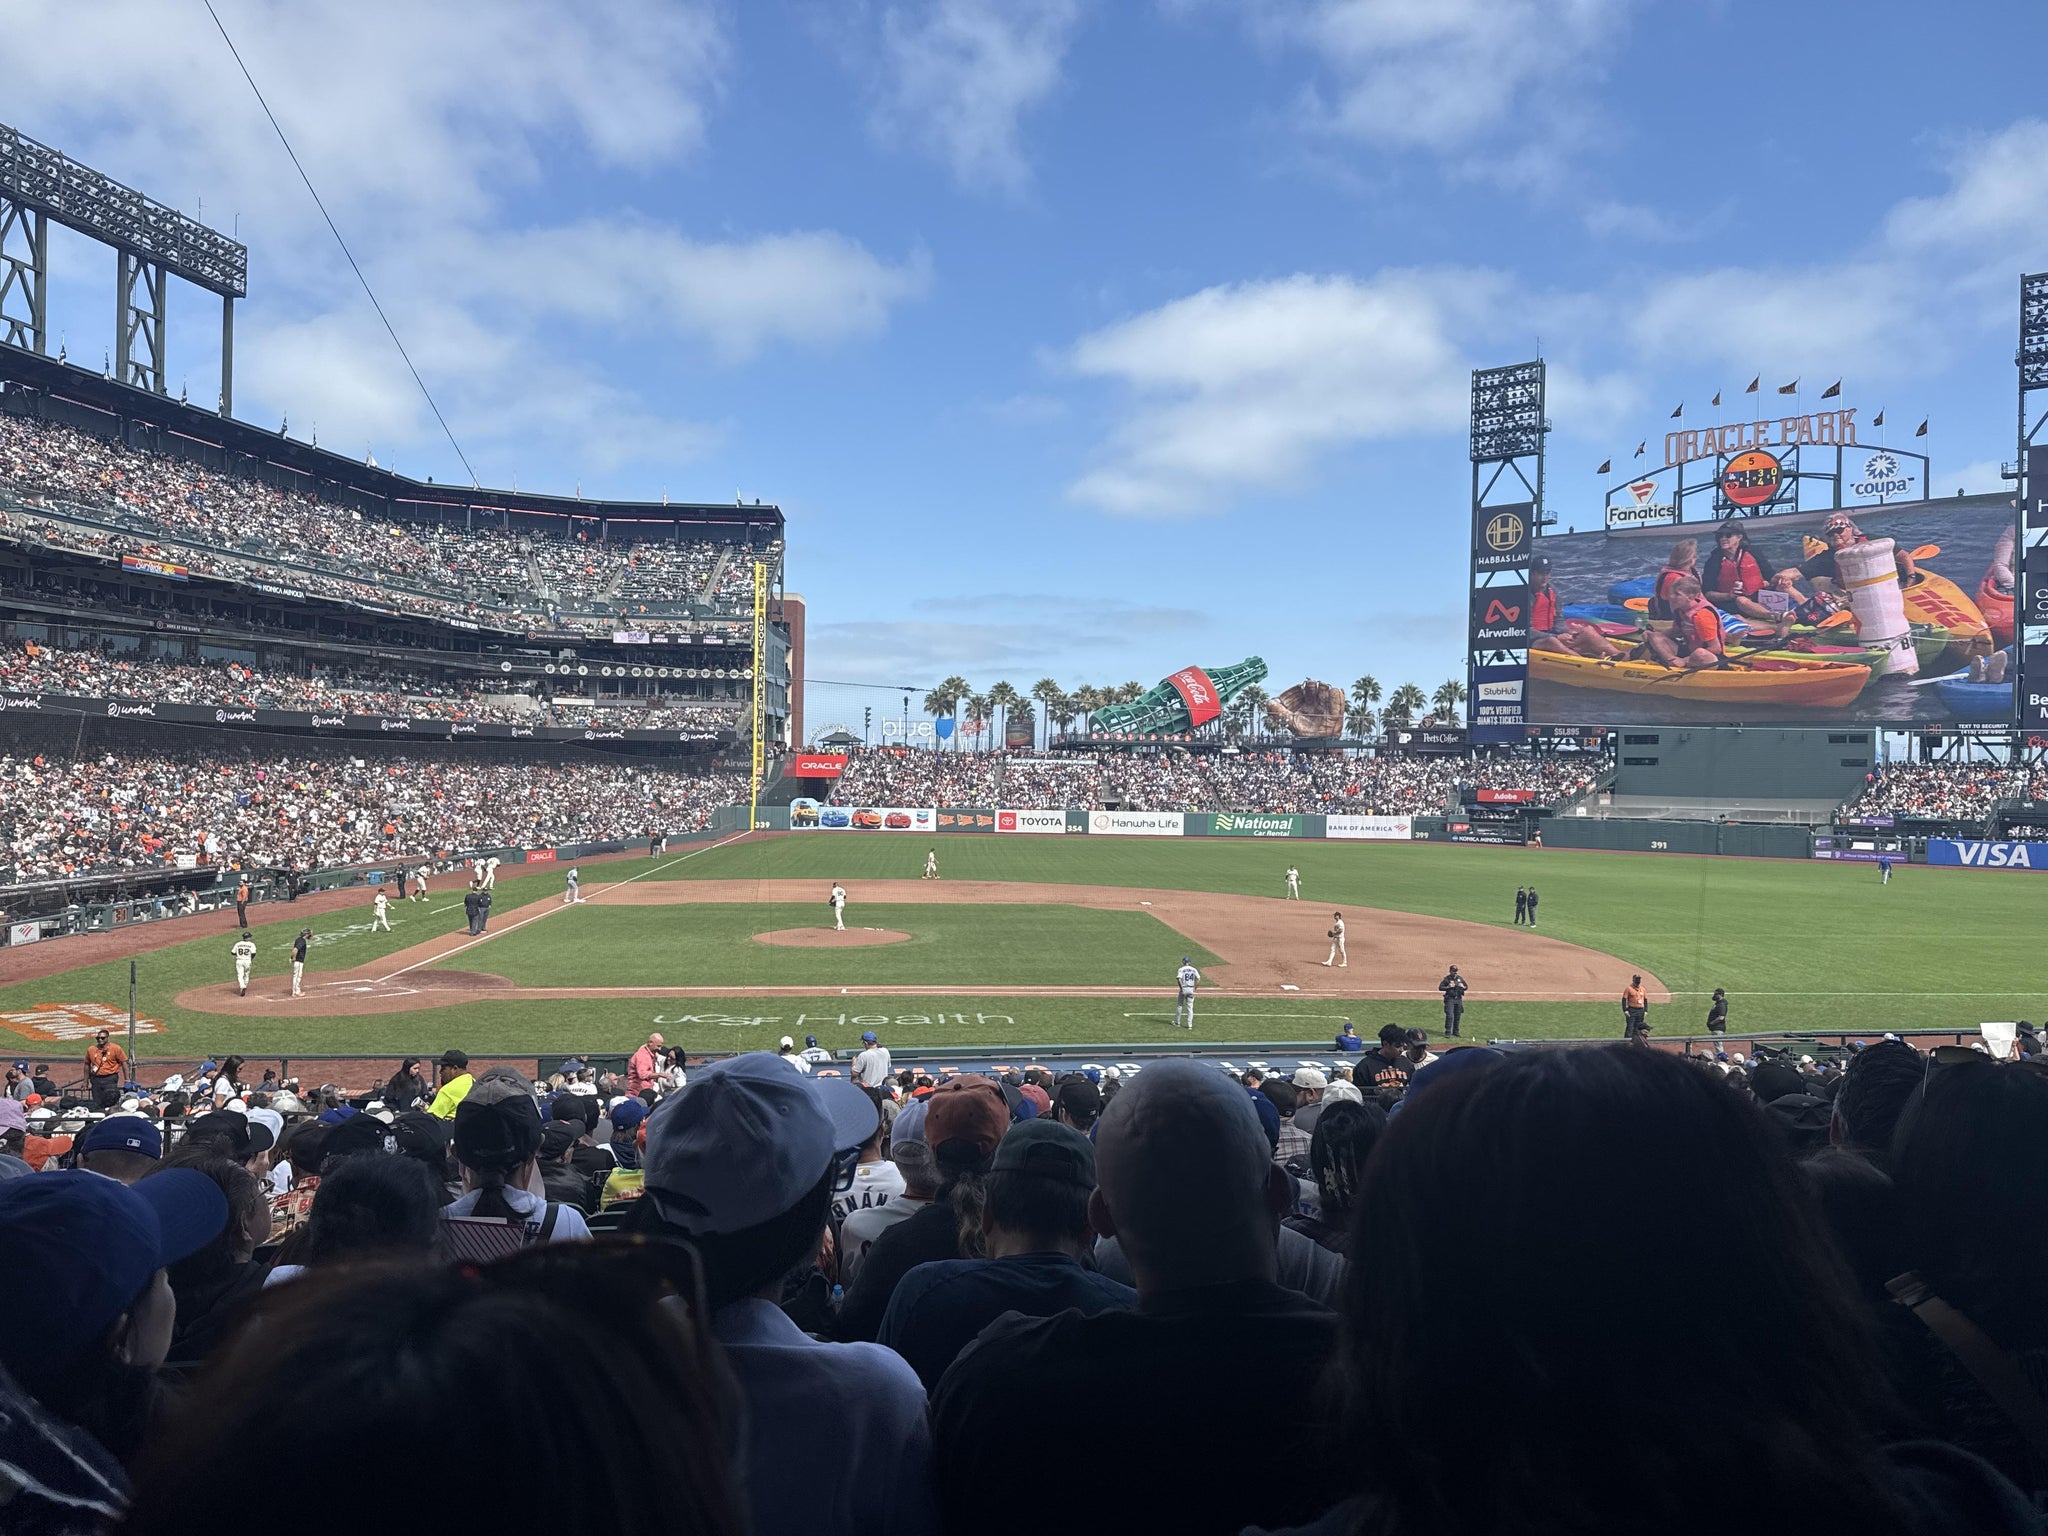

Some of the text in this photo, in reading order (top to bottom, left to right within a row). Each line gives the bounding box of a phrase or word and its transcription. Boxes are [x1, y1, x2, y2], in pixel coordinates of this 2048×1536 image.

[1665, 408, 1858, 467] ORACLE PARK
[1749, 457, 1755, 466] 5
[1855, 478, 1908, 496] coupa
[1609, 504, 1674, 522] Fanatics
[1478, 553, 1530, 565] HABBAS LAW
[262, 584, 305, 598] KONICA MINOLTA
[1477, 627, 1527, 639] Airwallex
[1483, 687, 1518, 696] StubHub
[1479, 705, 1522, 716] 100% VERIFIED
[1477, 714, 1523, 725] GIANTS TICKETS
[882, 716, 932, 737] blue
[1440, 733, 1459, 744] Coffee
[801, 762, 843, 770] ORACLE
[1493, 792, 1518, 800] Adobe
[755, 821, 771, 829] 339
[1020, 817, 1063, 827] TOYOTA
[1112, 818, 1180, 829] Hanwha Life
[1234, 816, 1294, 830] National
[1415, 831, 1429, 839] 399
[1459, 835, 1480, 843] KONICA
[1651, 841, 1668, 849] 391
[530, 852, 553, 861] ORACLE
[1951, 842, 2031, 868] VISA
[1184, 973, 1194, 981] 84
[795, 1012, 1015, 1026] Health
[1374, 1069, 1408, 1082] GIANTS
